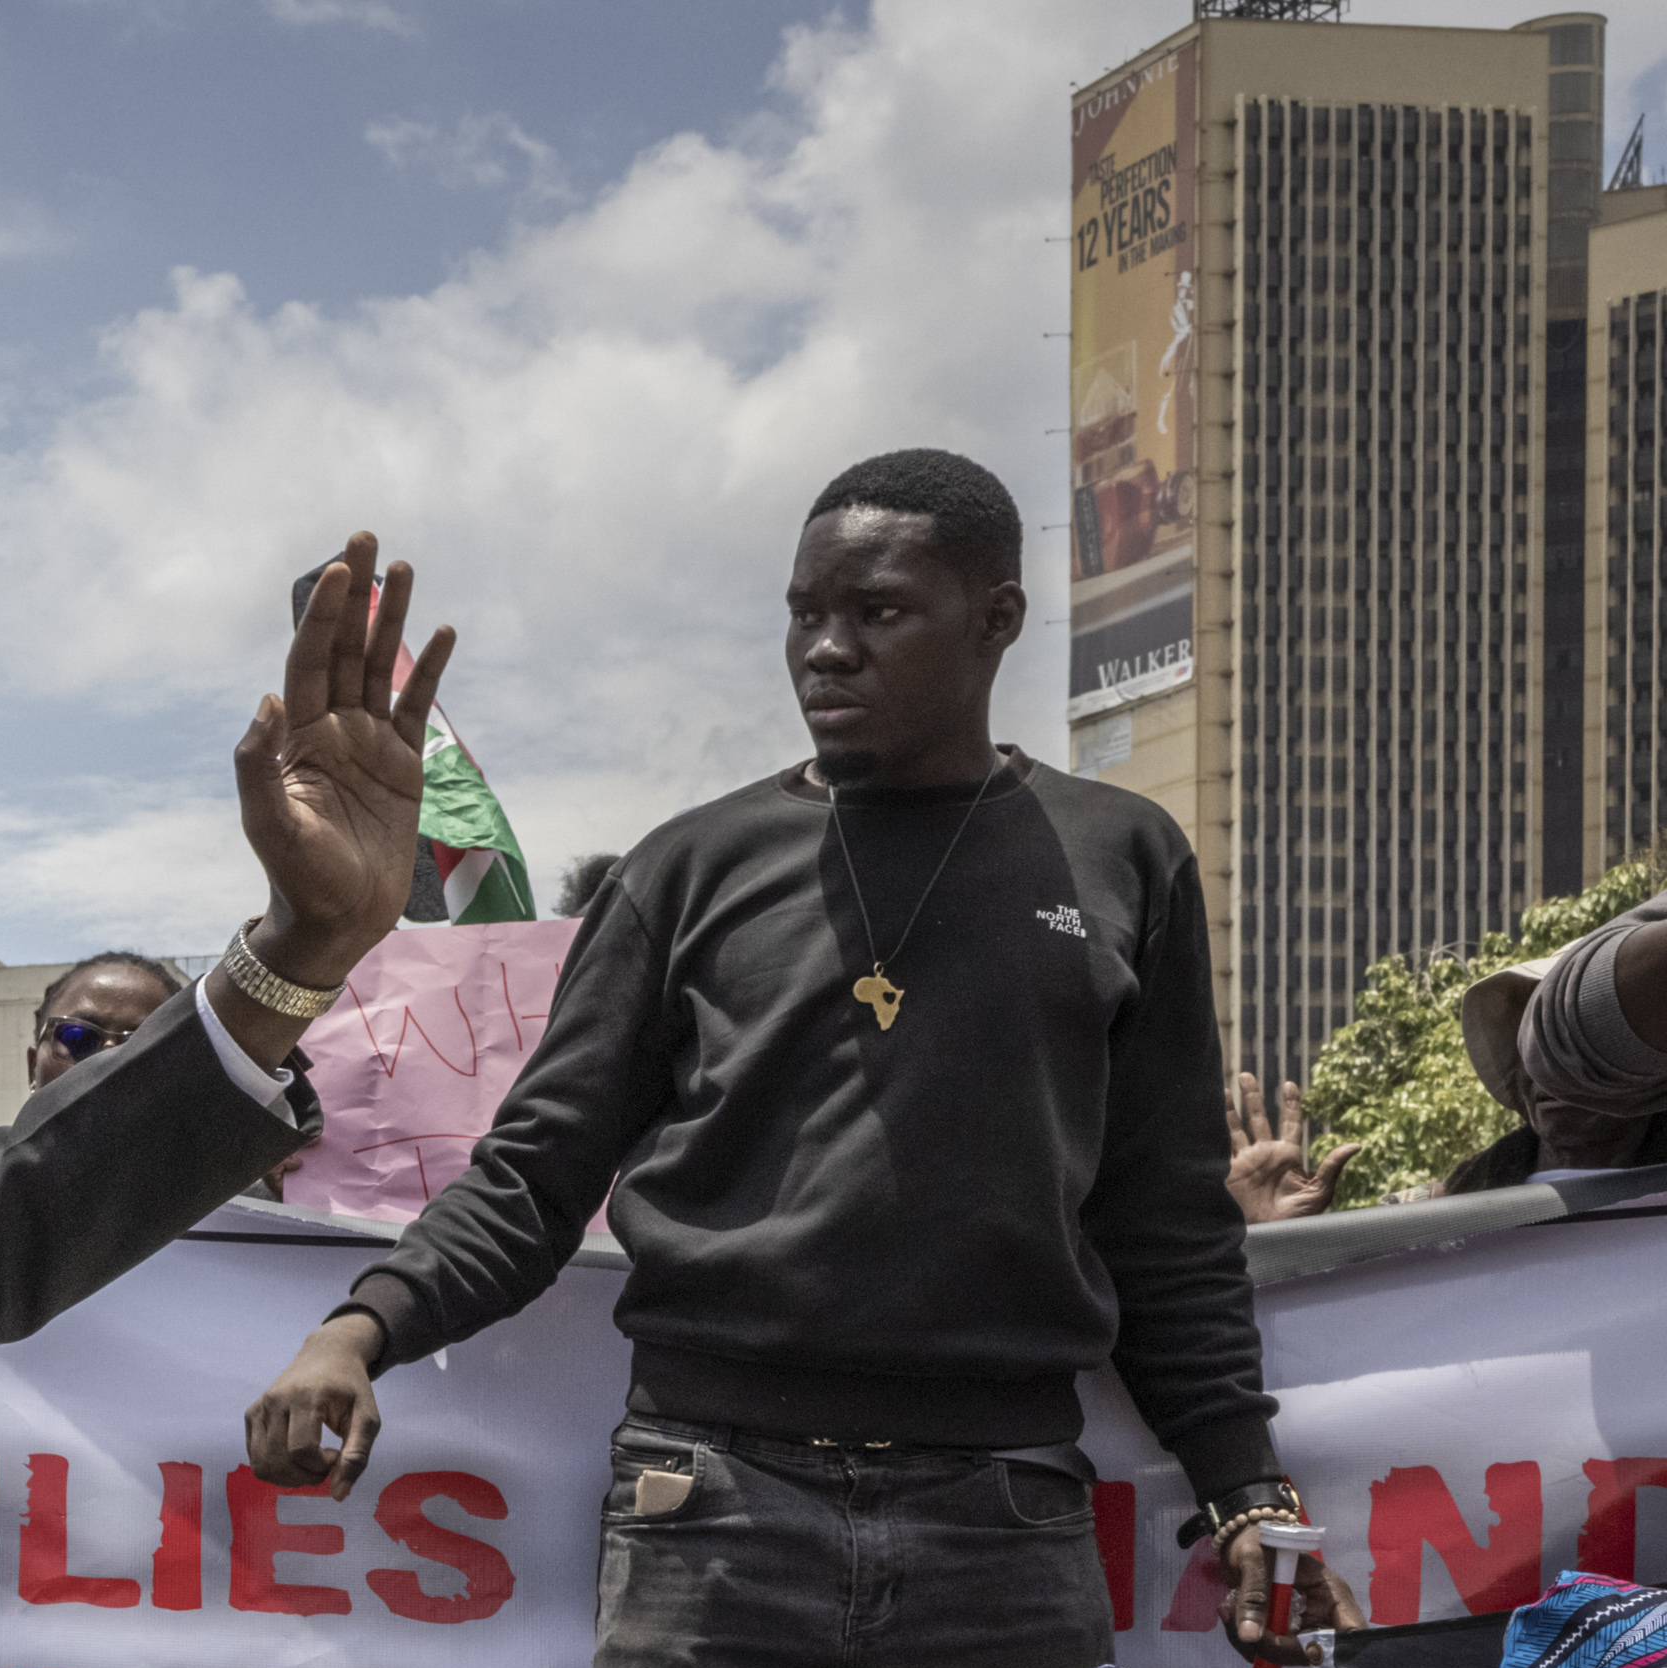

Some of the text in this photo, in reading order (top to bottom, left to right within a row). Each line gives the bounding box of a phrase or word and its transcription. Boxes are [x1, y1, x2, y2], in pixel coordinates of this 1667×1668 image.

[1074, 52, 1179, 137] JOHNNIE
[1088, 152, 1117, 187] TASTE
[1100, 141, 1177, 210] PERFECTION
[1078, 178, 1171, 272] 12 YEARS
[1098, 639, 1191, 690] WALKER
[1036, 910, 1081, 927] NORTH
[1050, 921, 1081, 937] FACE
[1056, 904, 1080, 918] THE
